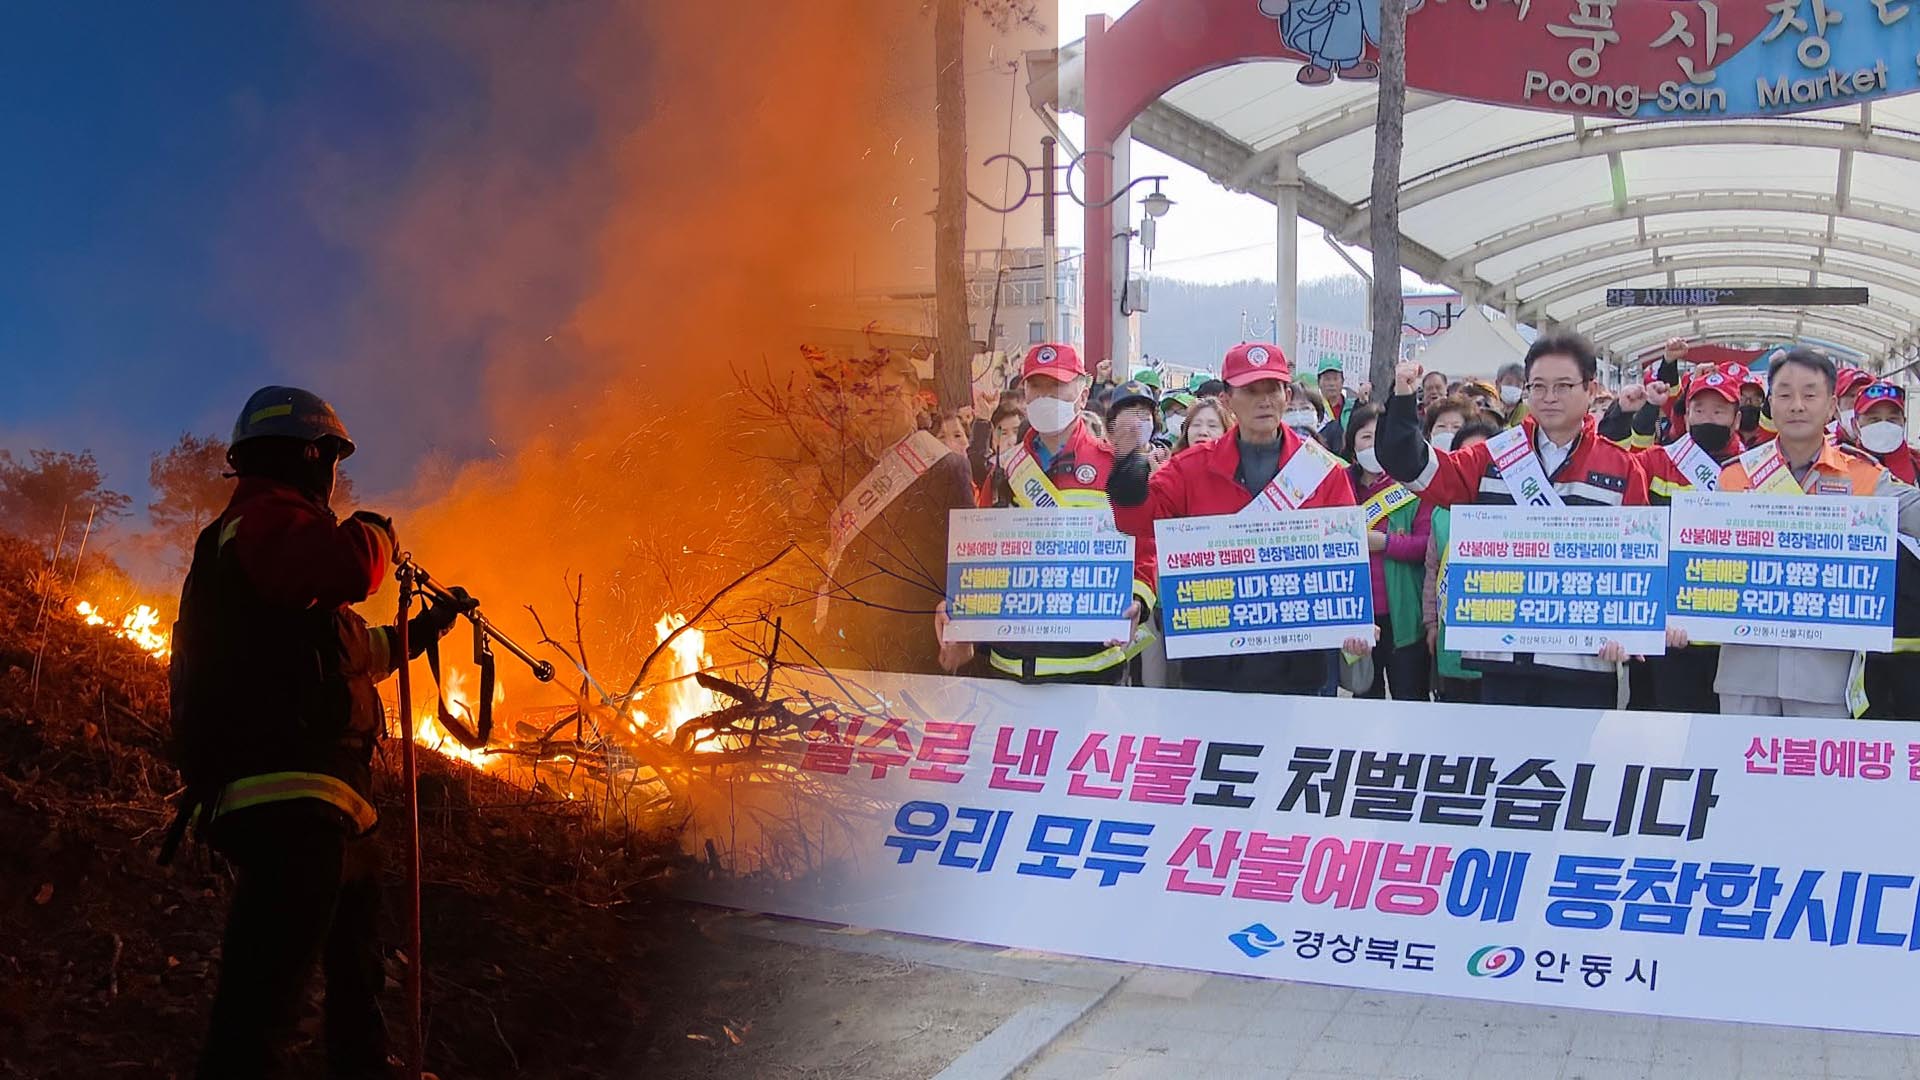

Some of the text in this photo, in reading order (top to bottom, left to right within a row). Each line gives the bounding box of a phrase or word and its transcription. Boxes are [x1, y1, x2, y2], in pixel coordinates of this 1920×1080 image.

[1523, 70, 1727, 115] Poong-San
[1756, 58, 1888, 109] Market
[956, 540, 1126, 555] 산불예방 캠페인 현장릴레이 챌린지
[1167, 542, 1359, 569] 산불예방 캠페인 현장릴레이 챌린지
[1458, 542, 1658, 559] 산불예방 캠페인 현장릴레이 챌린지
[1680, 529, 1887, 552] 산불예방 캠페인 현장릴레이 챌린지
[960, 567, 1119, 589] 산불예방 내가 앞장 섭니다!
[1177, 570, 1354, 602] 산불예방 내가 앞장 섭니다!
[1464, 570, 1525, 594] 산불예방
[1528, 571, 1559, 595] 내가
[1562, 572, 1594, 595] 앞장
[1597, 572, 1651, 596] 섭니다!
[1686, 558, 1879, 590] 산불예방 내가 앞장 섭니다!
[953, 593, 1124, 615] 산불예방 우리가 앞장 섭니다!
[1173, 597, 1364, 631] 산불예방 우리가 앞장 섭니다!
[1455, 599, 1658, 625] 산불예방 우리가 앞장 섭니다!
[1676, 587, 1885, 621] 산불예방 우리가 앞장 섭니다!
[1744, 737, 1895, 781] 산불예방
[800, 715, 1720, 841] 실수로 낸 산불도 처벌받습니다
[884, 800, 1014, 873] 우리
[1017, 814, 1156, 888] 모두
[1165, 827, 1531, 923] 산불예방에
[1292, 930, 1436, 972] 경상북도
